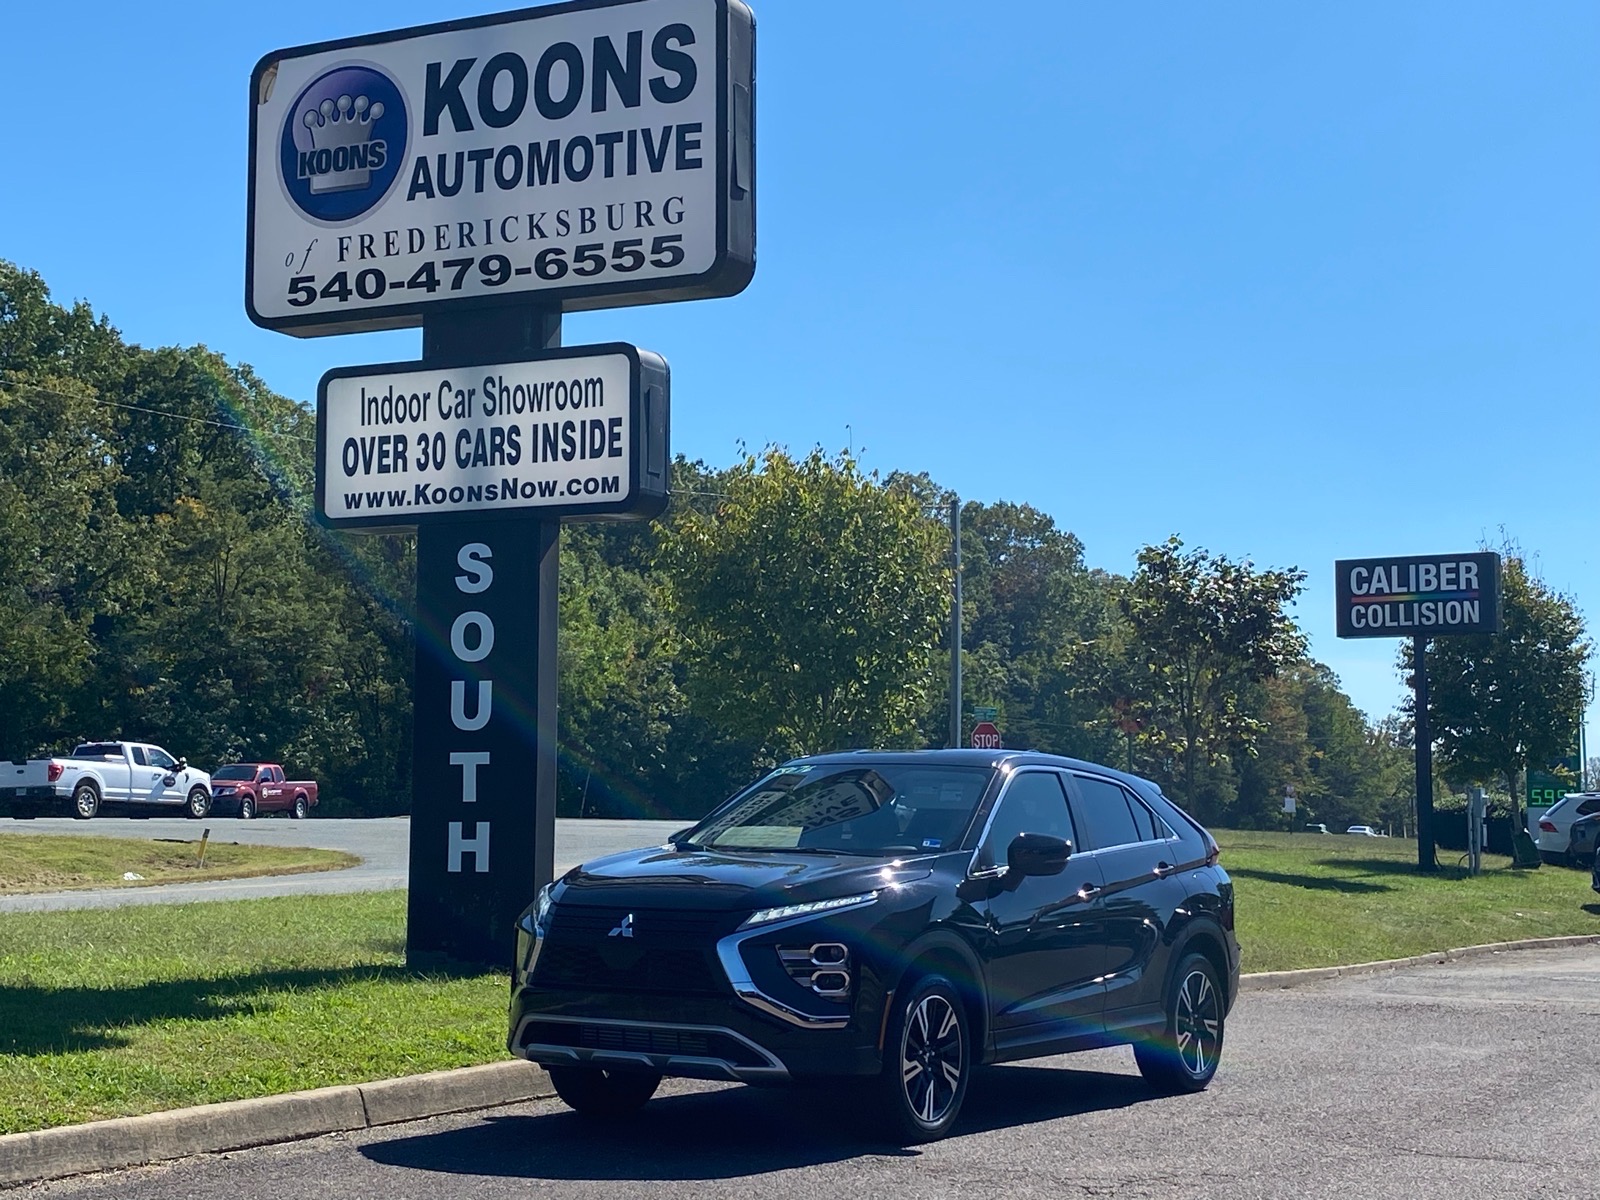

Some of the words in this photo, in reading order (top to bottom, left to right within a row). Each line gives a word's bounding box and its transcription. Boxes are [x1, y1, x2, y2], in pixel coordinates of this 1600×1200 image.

[422, 22, 697, 136] KOONS
[299, 141, 386, 177] KOONS
[406, 122, 703, 201] AUTOMOTIVE
[285, 239, 318, 274] of
[337, 196, 685, 262] FREDERICKSBURG
[287, 234, 684, 307] 540-479-6555
[361, 385, 431, 426] Indoor
[438, 380, 476, 420] Car
[482, 376, 604, 416] Showroom
[342, 434, 408, 477] OVER
[416, 433, 446, 472] 30
[455, 425, 521, 469] CARS
[532, 417, 622, 463] INSIDE
[1350, 561, 1479, 595] CALIBER
[1351, 601, 1480, 628] COLLISION
[447, 543, 495, 873] SOUTH
[974, 734, 999, 749] STOP
